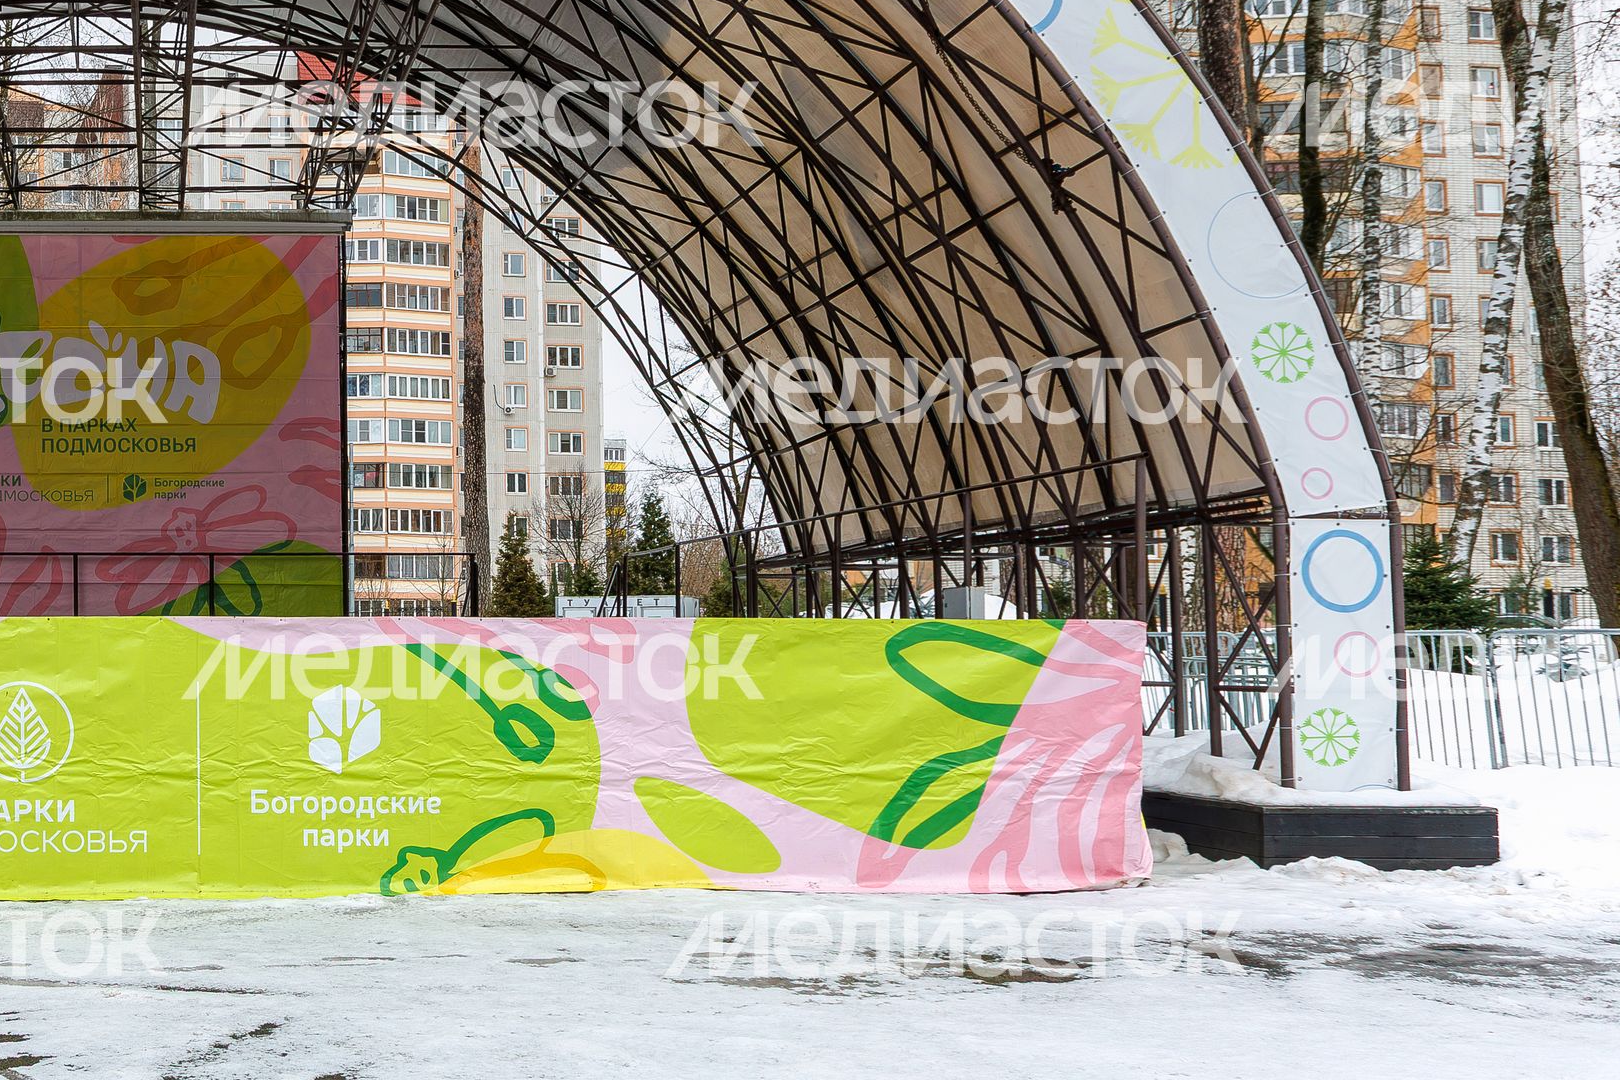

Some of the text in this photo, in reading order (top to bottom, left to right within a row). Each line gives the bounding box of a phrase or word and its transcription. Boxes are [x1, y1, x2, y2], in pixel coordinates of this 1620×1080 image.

[41, 417, 137, 433] В ПАРКАХ
[41, 437, 197, 456] ПОДМОСКОВЬЯ
[153, 477, 225, 489] Богородские
[154, 490, 187, 502] парки
[567, 598, 660, 608] ТУЕТ
[249, 788, 442, 817] Богородские
[302, 826, 390, 854] парки
